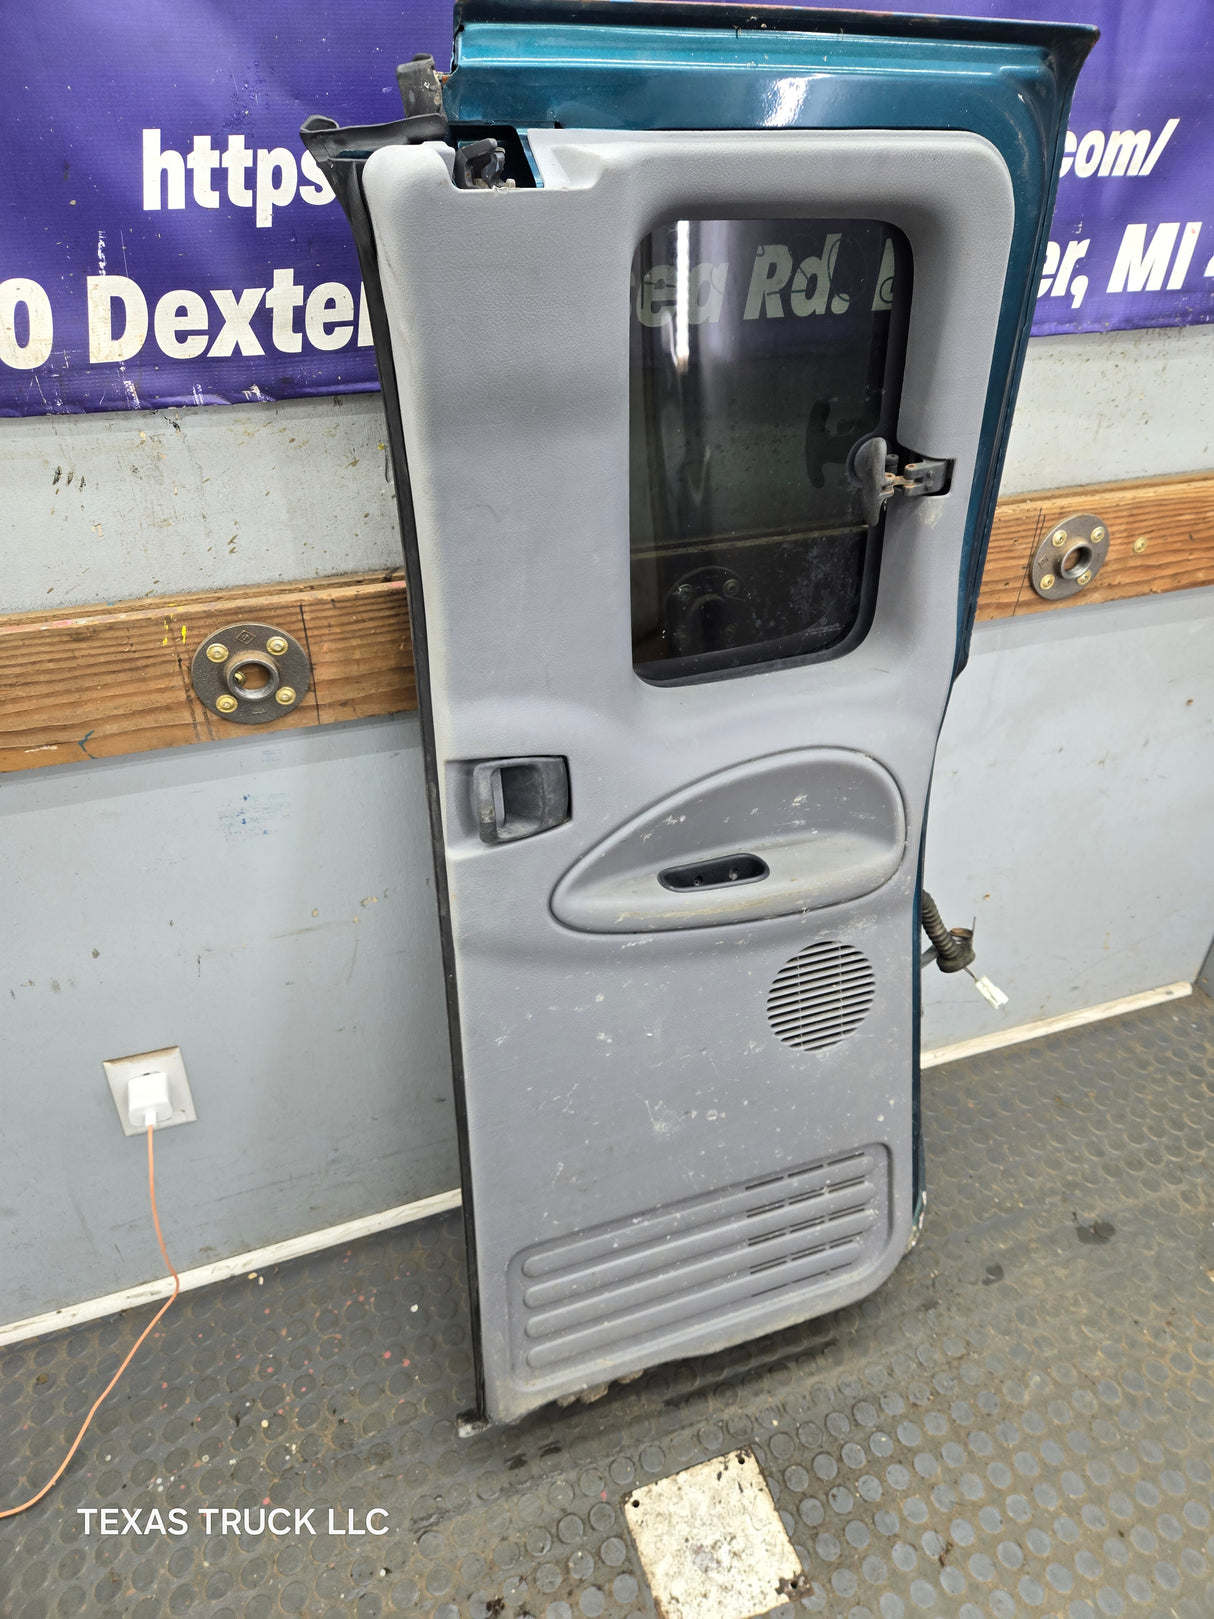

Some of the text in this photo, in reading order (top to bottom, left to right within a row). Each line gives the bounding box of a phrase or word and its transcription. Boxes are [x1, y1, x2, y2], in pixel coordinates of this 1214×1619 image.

[143, 129, 336, 228] https
[630, 264, 729, 328] ea
[743, 233, 849, 320] Rd.
[1106, 221, 1202, 293] MI
